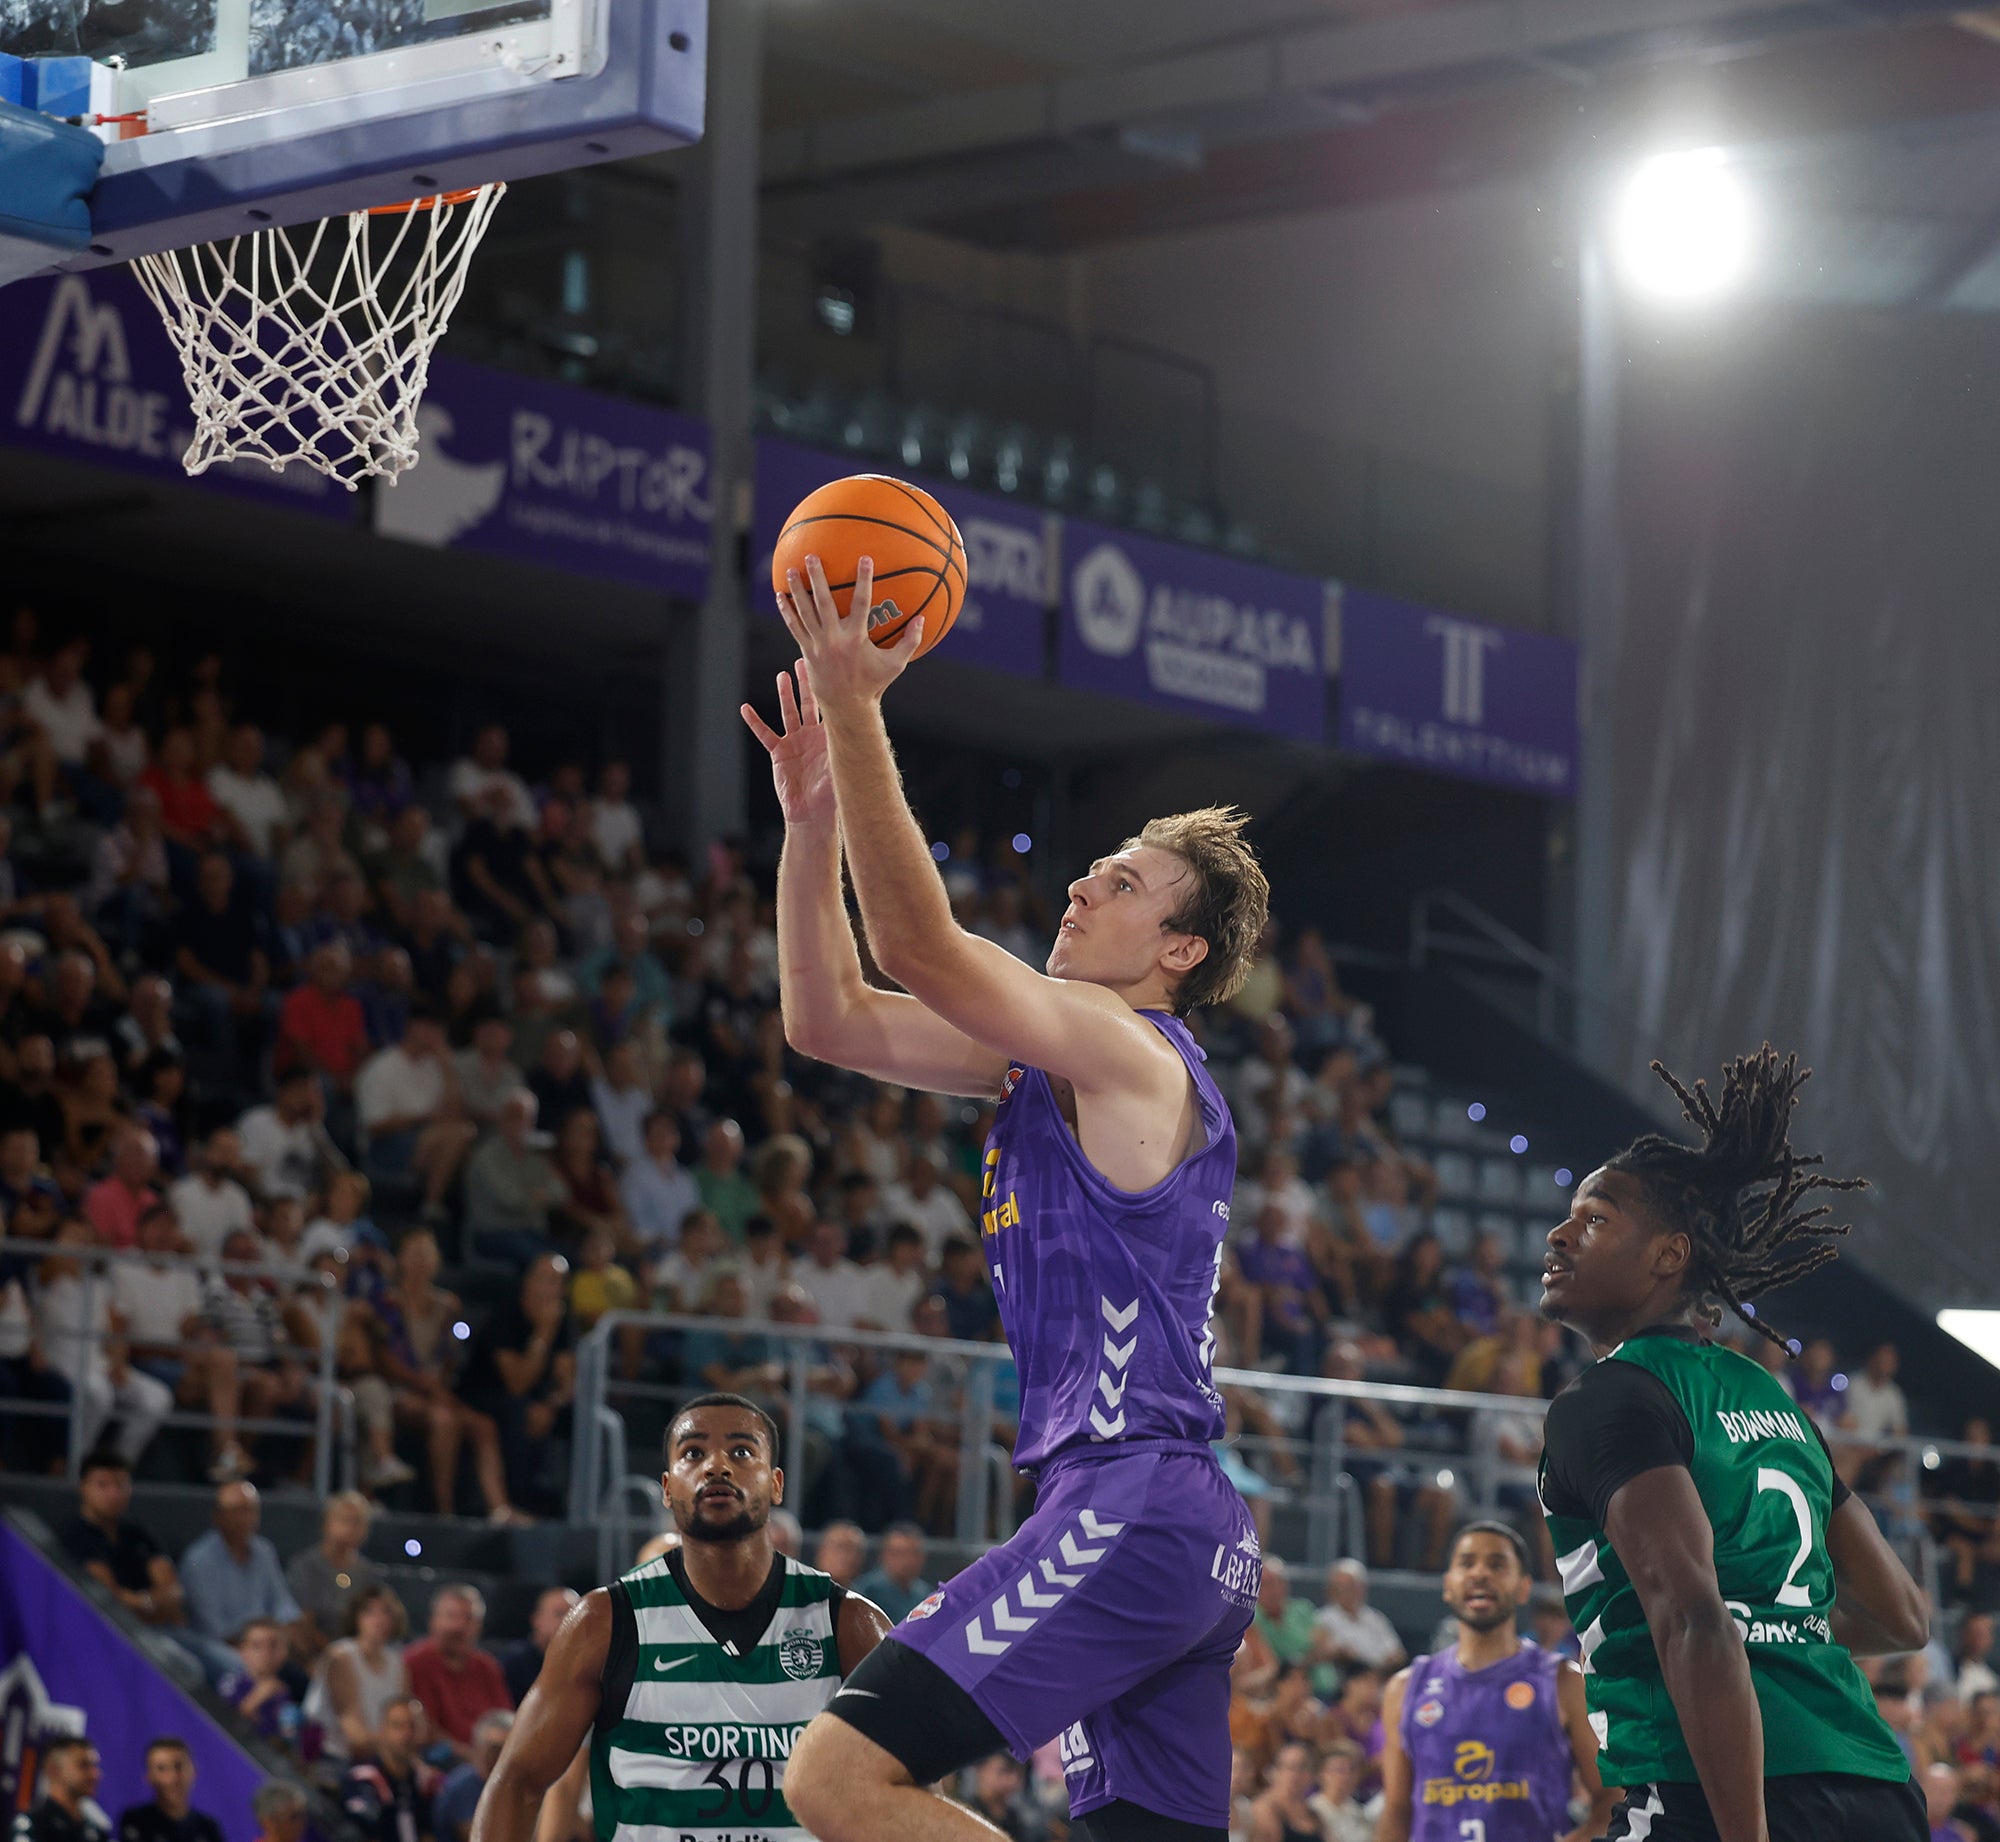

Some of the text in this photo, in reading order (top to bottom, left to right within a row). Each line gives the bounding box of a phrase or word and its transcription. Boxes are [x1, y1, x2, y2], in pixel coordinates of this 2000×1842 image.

[48, 371, 169, 456] ALDE
[1151, 582, 1315, 674] AUPASA
[1716, 1410, 1807, 1444] BOWMAN
[1757, 1467, 1812, 1607] 2
[1423, 1778, 1529, 1807] agropal
